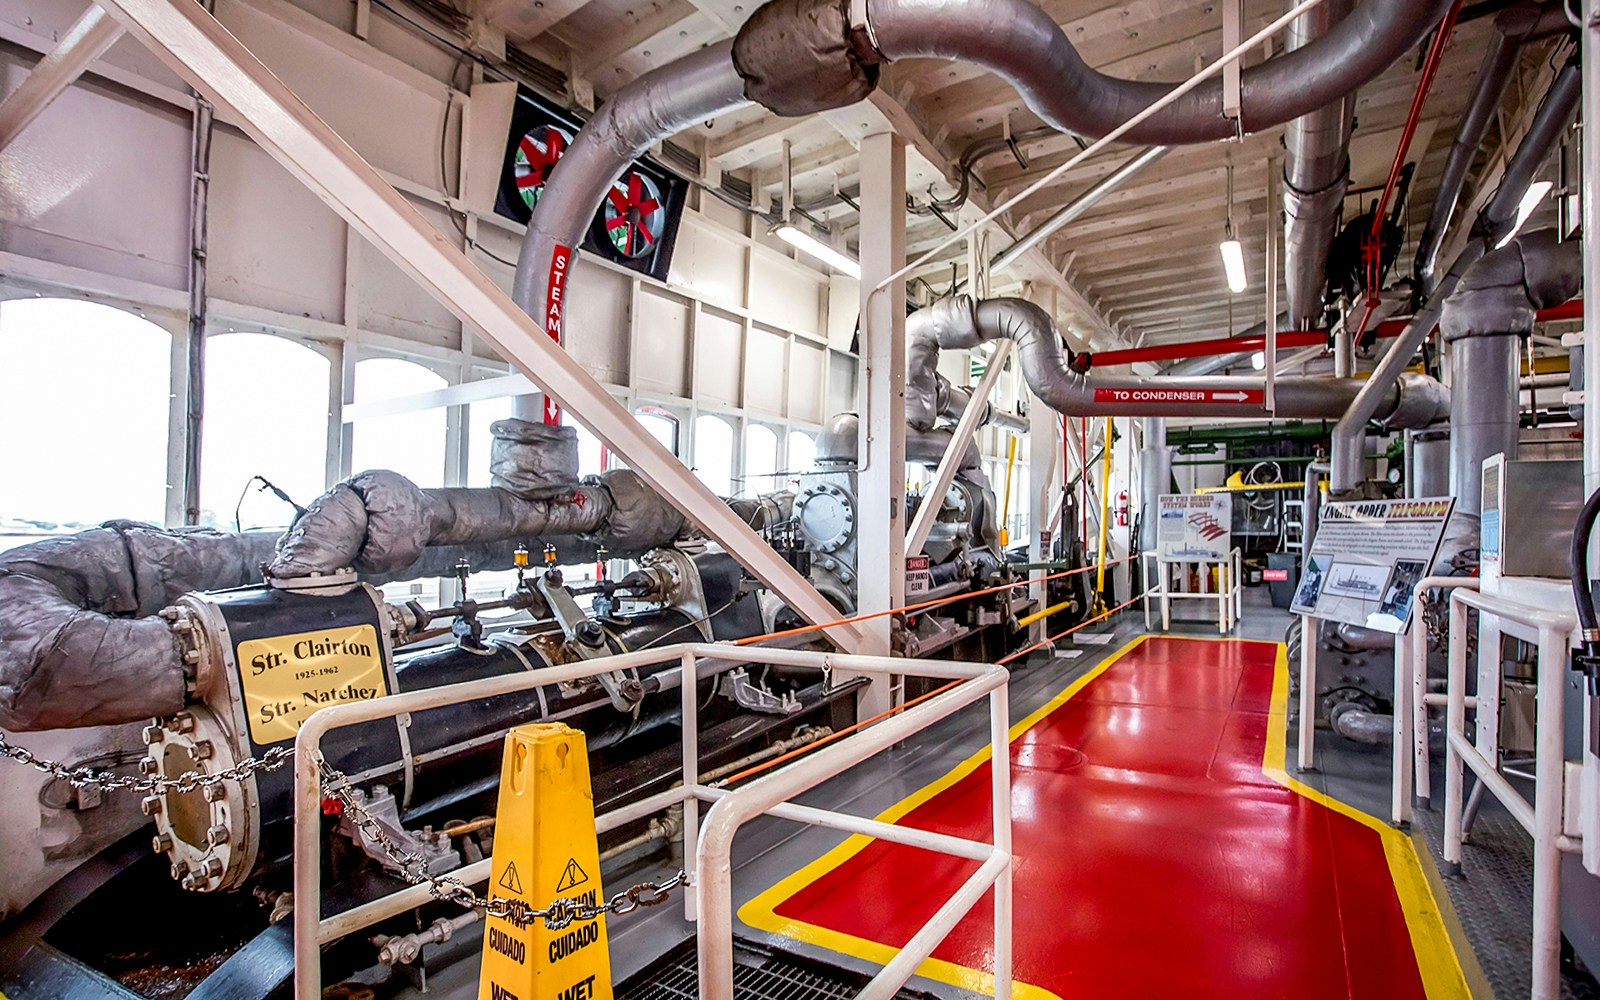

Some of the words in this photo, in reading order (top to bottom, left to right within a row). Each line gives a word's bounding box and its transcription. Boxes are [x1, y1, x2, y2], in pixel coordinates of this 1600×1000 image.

[548, 255, 566, 331] STEAM
[1113, 391, 1130, 400] TO
[1132, 391, 1205, 400] CONDENSER
[1324, 505, 1356, 519] ENGINE
[1355, 504, 1387, 519] ORDER
[1387, 500, 1450, 519] TELEGRAPH
[910, 559, 925, 568] DANGER
[906, 573, 915, 581] KEEP
[915, 572, 928, 581] HANDS
[911, 582, 923, 591] CLEAR
[251, 651, 288, 677] Str.
[293, 637, 371, 660] Clairton
[295, 666, 339, 681] 1925-1962
[260, 700, 297, 725] Str.
[303, 685, 378, 707] Natchez
[489, 926, 526, 965] CUIDADO
[548, 921, 599, 964] CUIDADO
[557, 974, 596, 1000] WET
